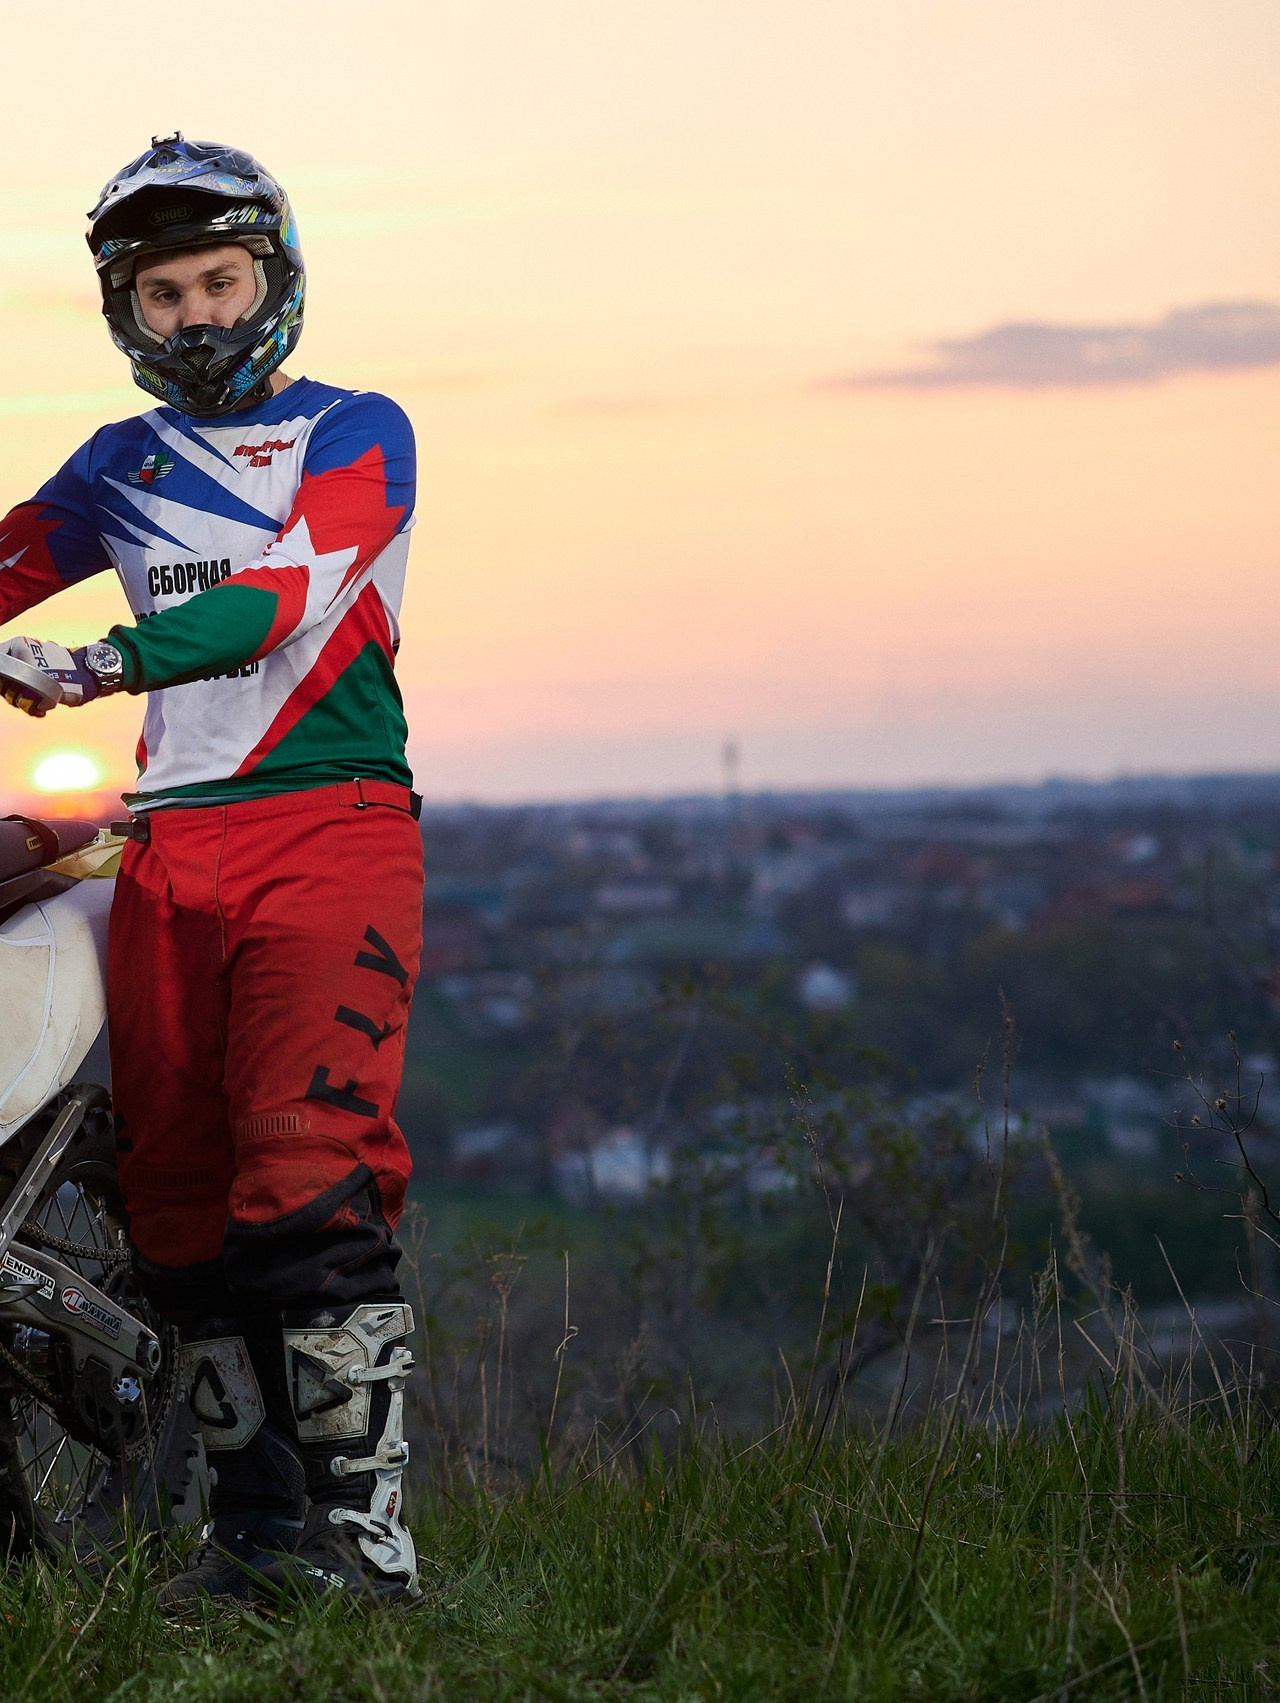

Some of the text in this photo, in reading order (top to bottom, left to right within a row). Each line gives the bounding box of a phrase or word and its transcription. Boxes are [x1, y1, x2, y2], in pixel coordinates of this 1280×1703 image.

[153, 206, 188, 222] SHOEI
[148, 558, 231, 597] СБОРНАЯ
[78, 1301, 120, 1333] MAXIMA
[305, 1566, 347, 1589] 3.5
